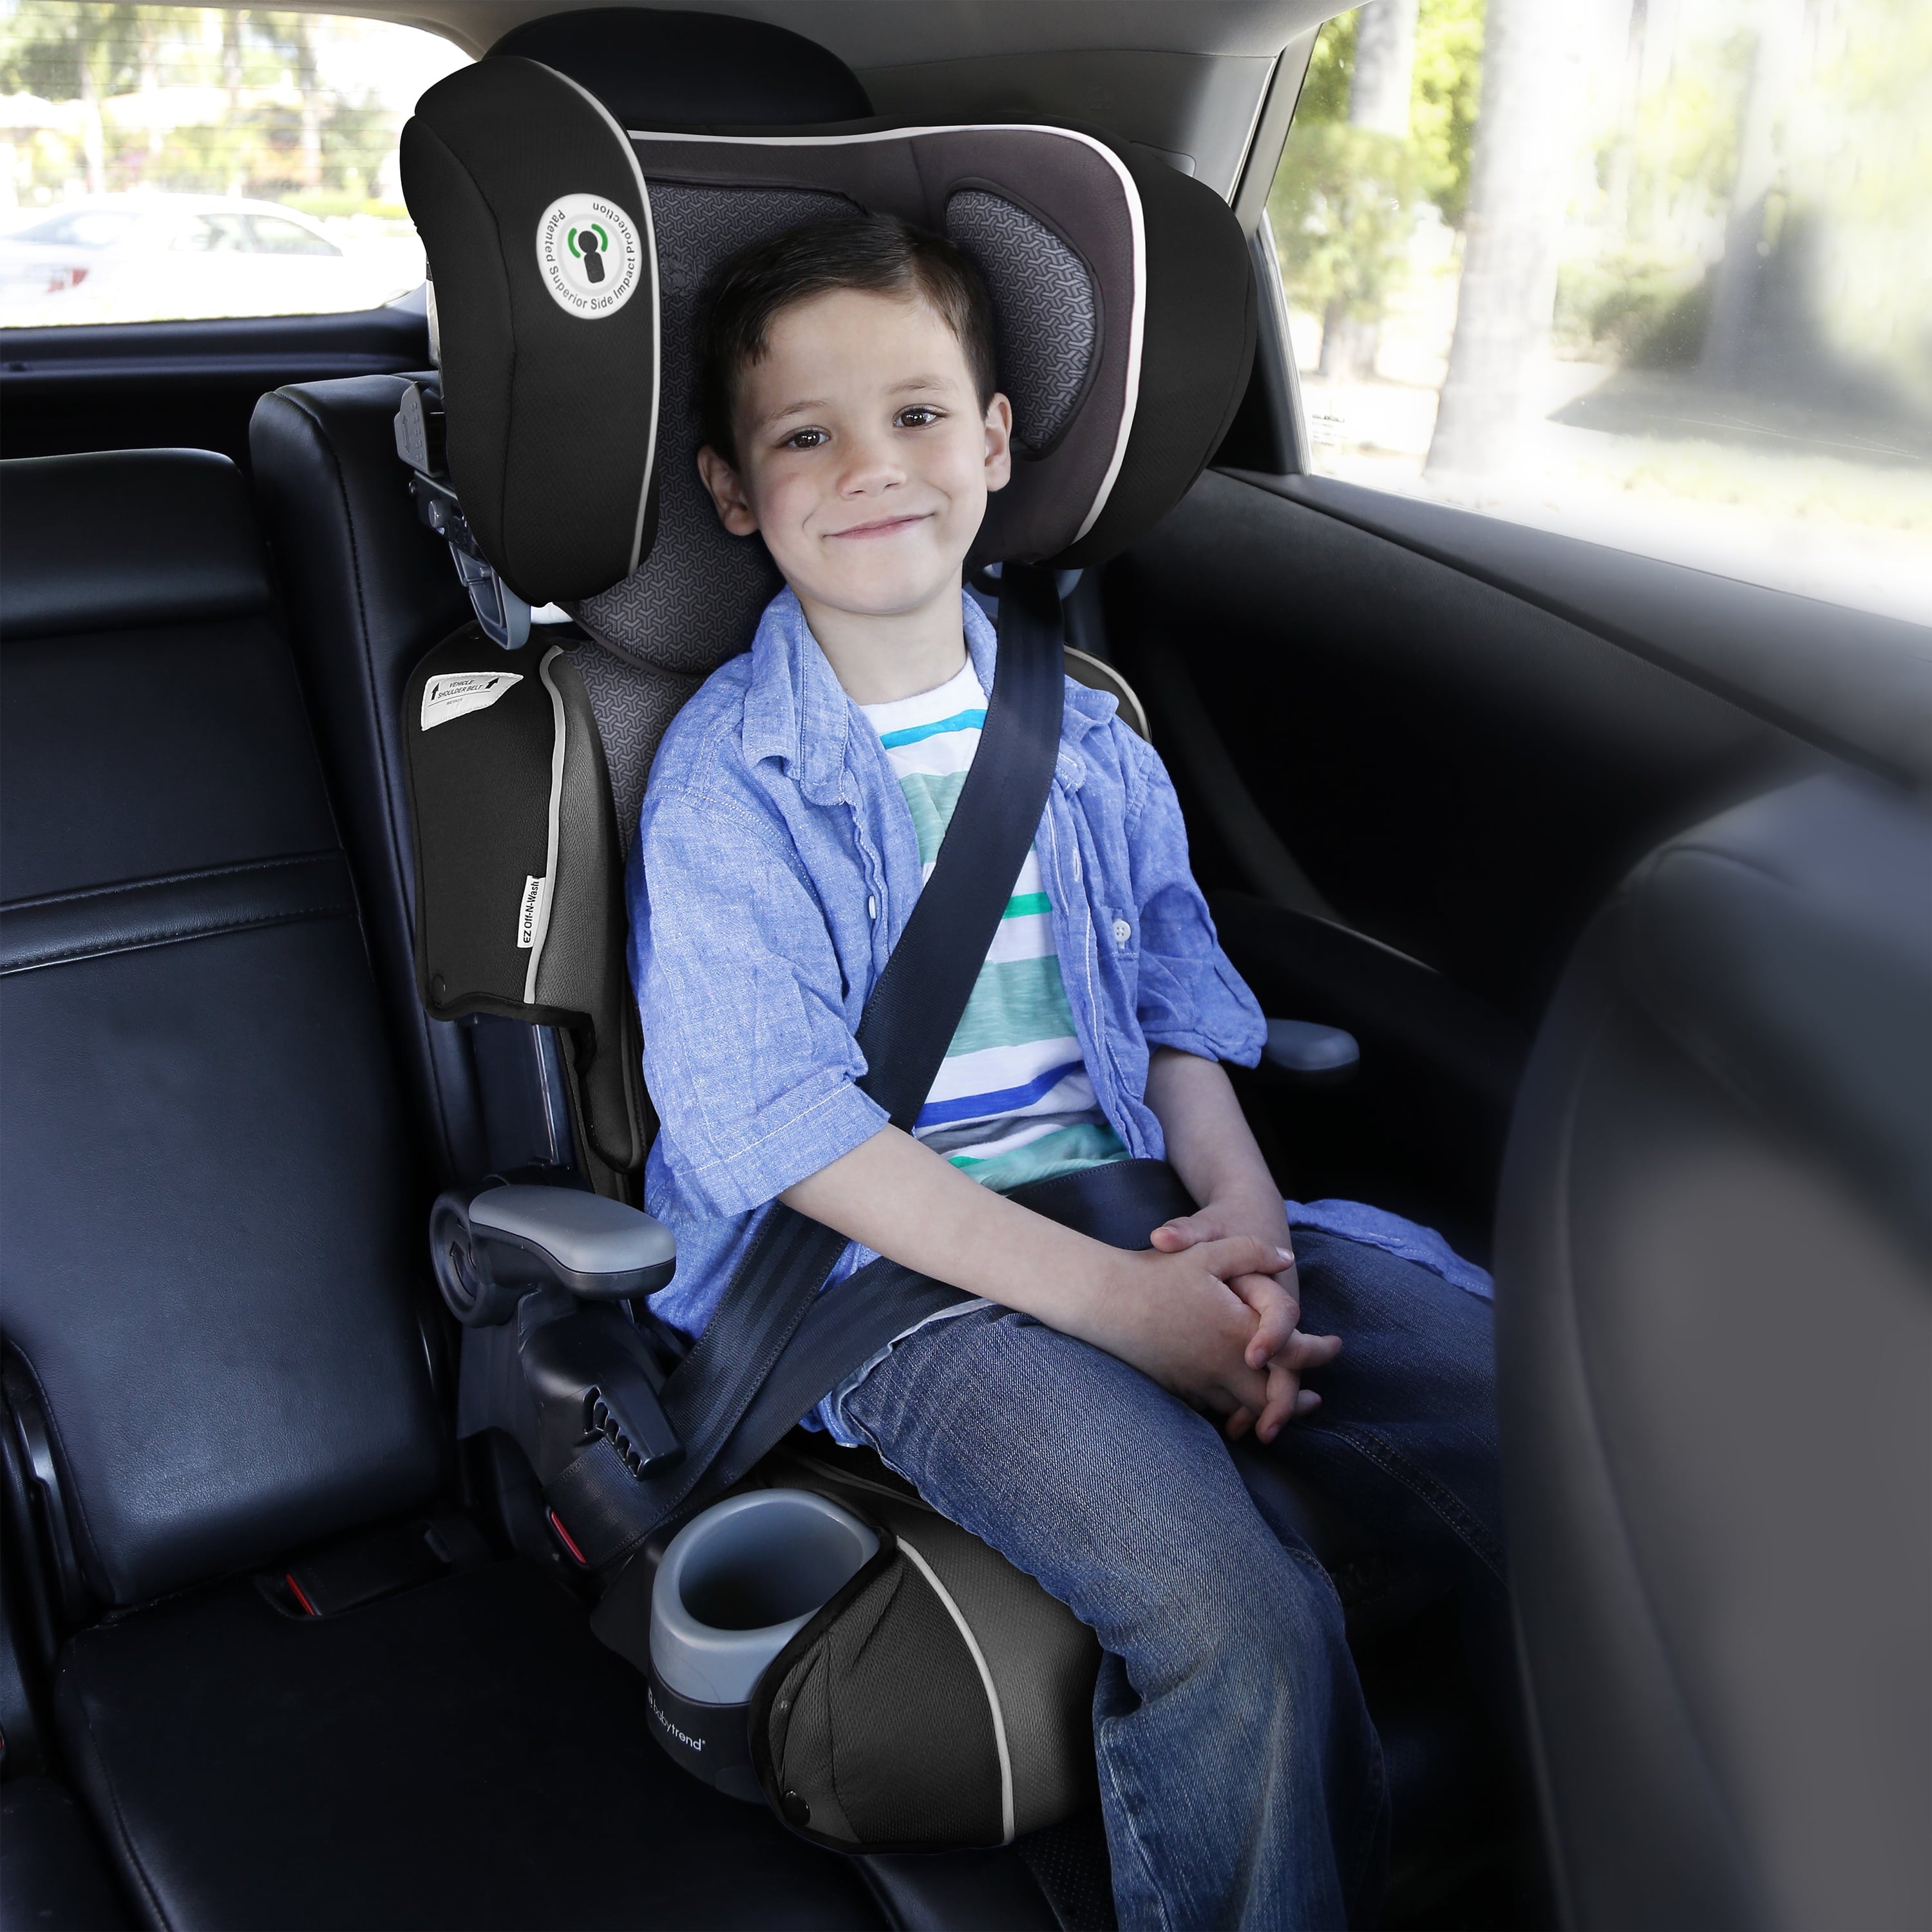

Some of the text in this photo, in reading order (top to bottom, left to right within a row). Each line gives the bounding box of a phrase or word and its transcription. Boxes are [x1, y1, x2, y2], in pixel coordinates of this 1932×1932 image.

[545, 202, 635, 310] Patented Superior Side Impact Protection
[438, 687, 467, 699] SHOULDER
[450, 679, 475, 688] VEHICLE
[523, 881, 540, 943] EZ Off-N-Wash
